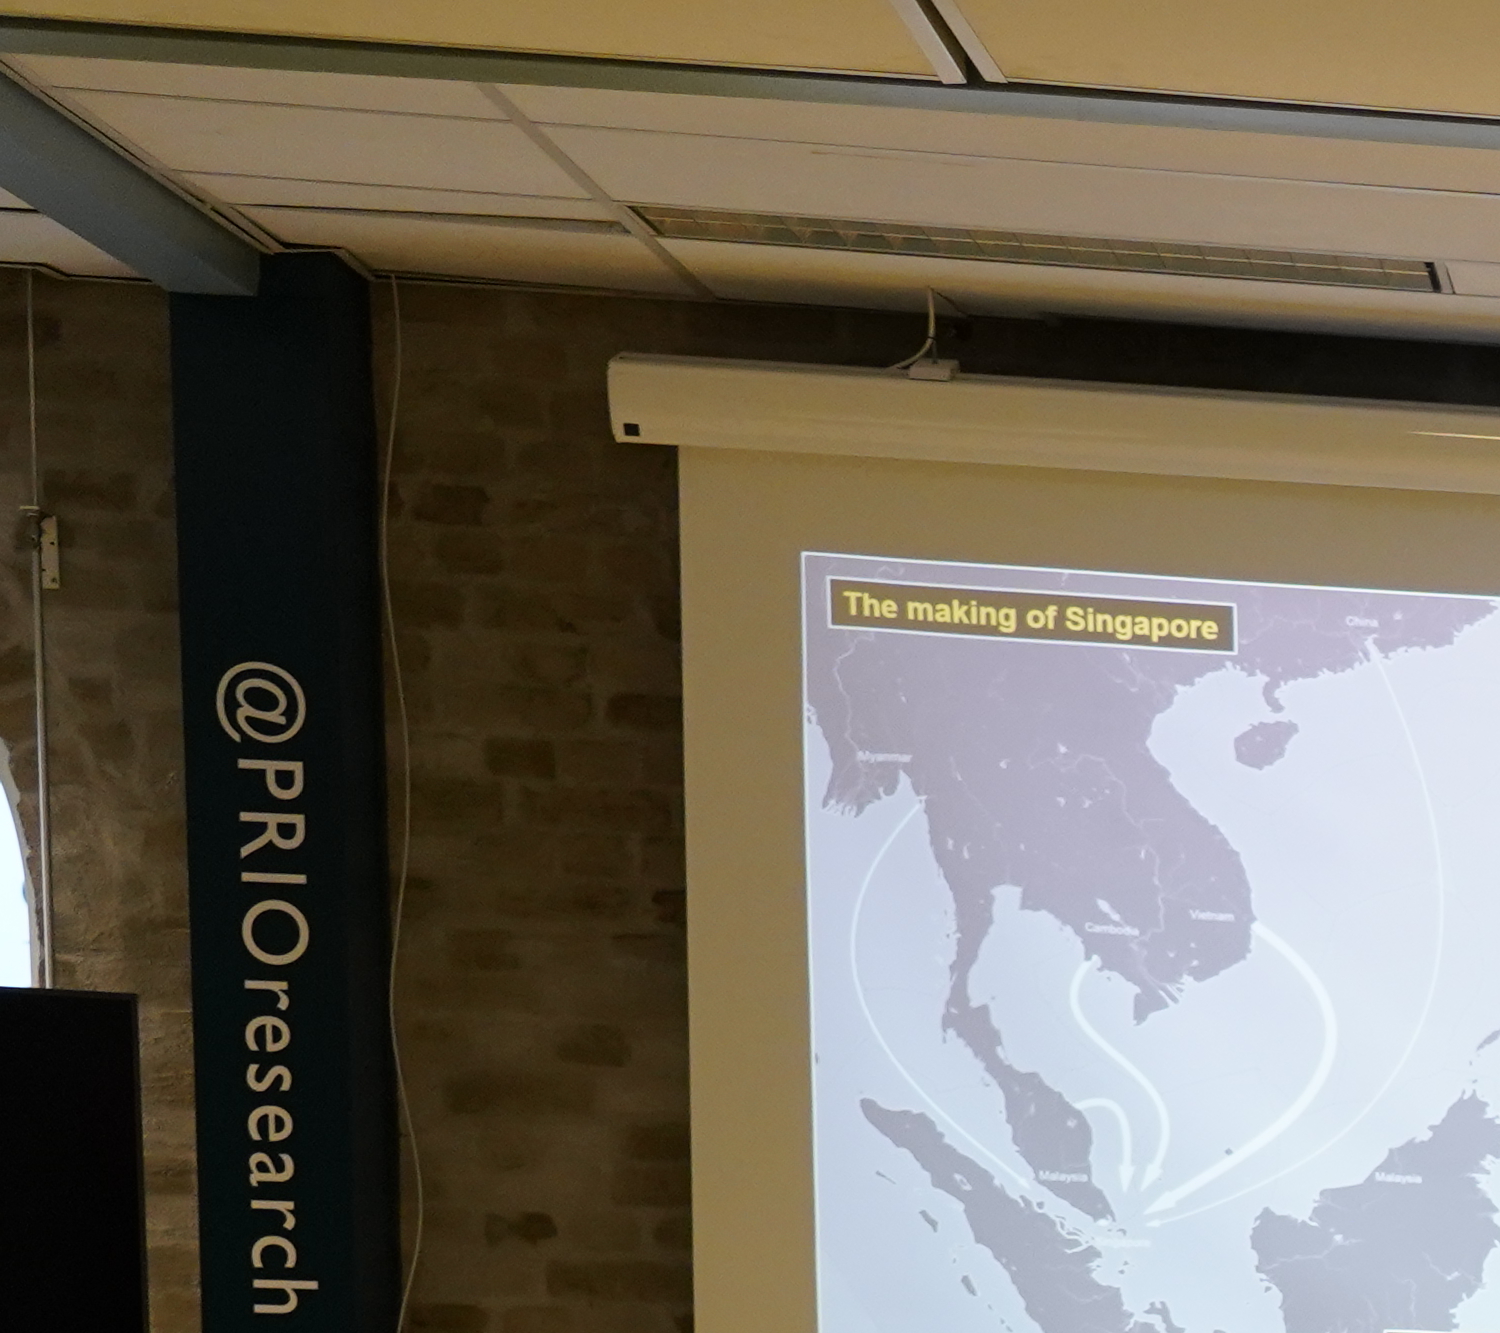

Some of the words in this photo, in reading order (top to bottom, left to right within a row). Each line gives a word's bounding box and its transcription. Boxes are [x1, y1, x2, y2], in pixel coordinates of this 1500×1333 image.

[843, 591, 898, 619] The
[907, 599, 1017, 633] making
[1027, 605, 1058, 630] of
[1065, 606, 1219, 642] Singapore
[1189, 909, 1235, 921] Vietnam
[1085, 922, 1140, 936] Cambodia
[216, 660, 319, 1314] @PRIOresearch
[1039, 1170, 1088, 1183] Malaysia
[1375, 1172, 1422, 1185] Malaysia
